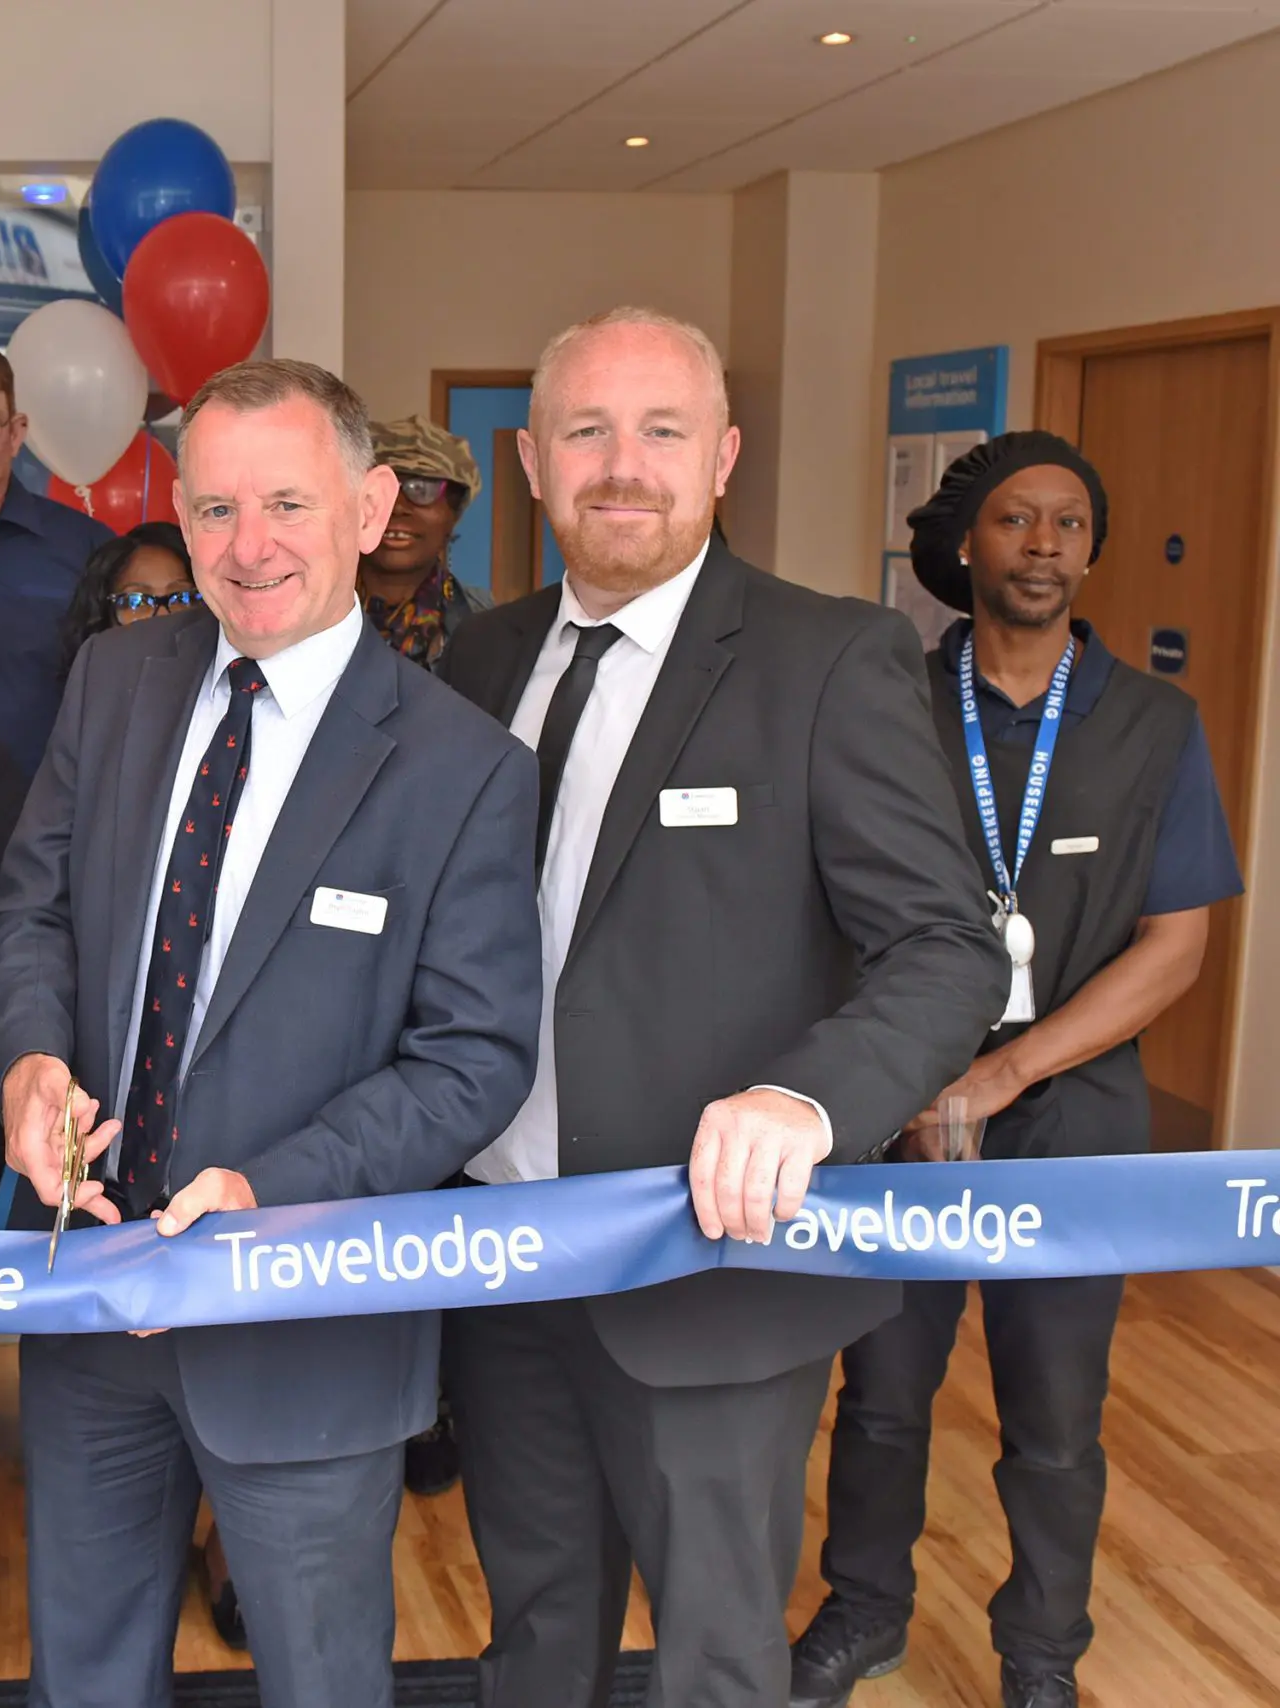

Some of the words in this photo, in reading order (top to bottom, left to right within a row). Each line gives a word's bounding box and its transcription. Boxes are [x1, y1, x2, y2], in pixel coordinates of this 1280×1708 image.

[905, 369, 937, 390] Local
[939, 364, 978, 387] travel
[905, 388, 978, 409] information
[971, 754, 1004, 884] HOUSEKEEPING
[1014, 751, 1049, 882] HOUSEKEEPIN
[745, 1188, 1042, 1264] avelodge
[1226, 1178, 1280, 1238] Tr
[214, 1213, 544, 1290] Travelodge
